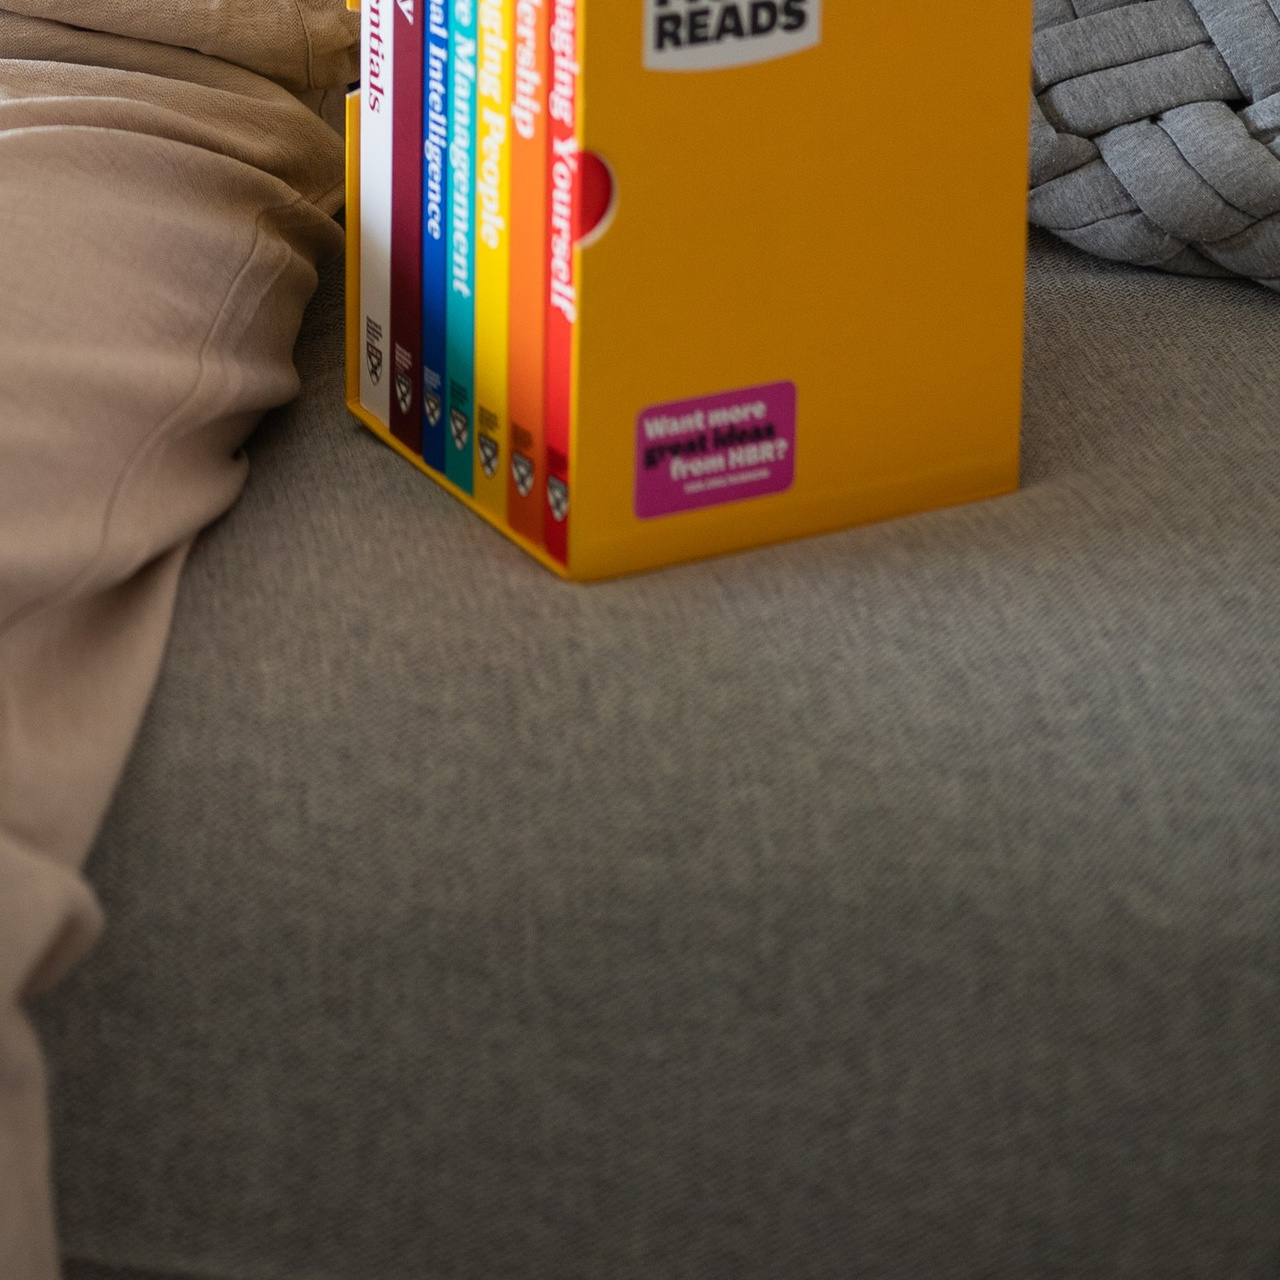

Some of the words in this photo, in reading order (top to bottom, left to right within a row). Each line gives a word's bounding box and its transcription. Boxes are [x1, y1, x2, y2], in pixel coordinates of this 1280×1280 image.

[424, 41, 448, 240] Intelligence
[449, 30, 477, 299] Management
[478, 106, 507, 250] People
[550, 134, 580, 324] Yourself
[644, 409, 705, 439] Want
[708, 400, 767, 428] more
